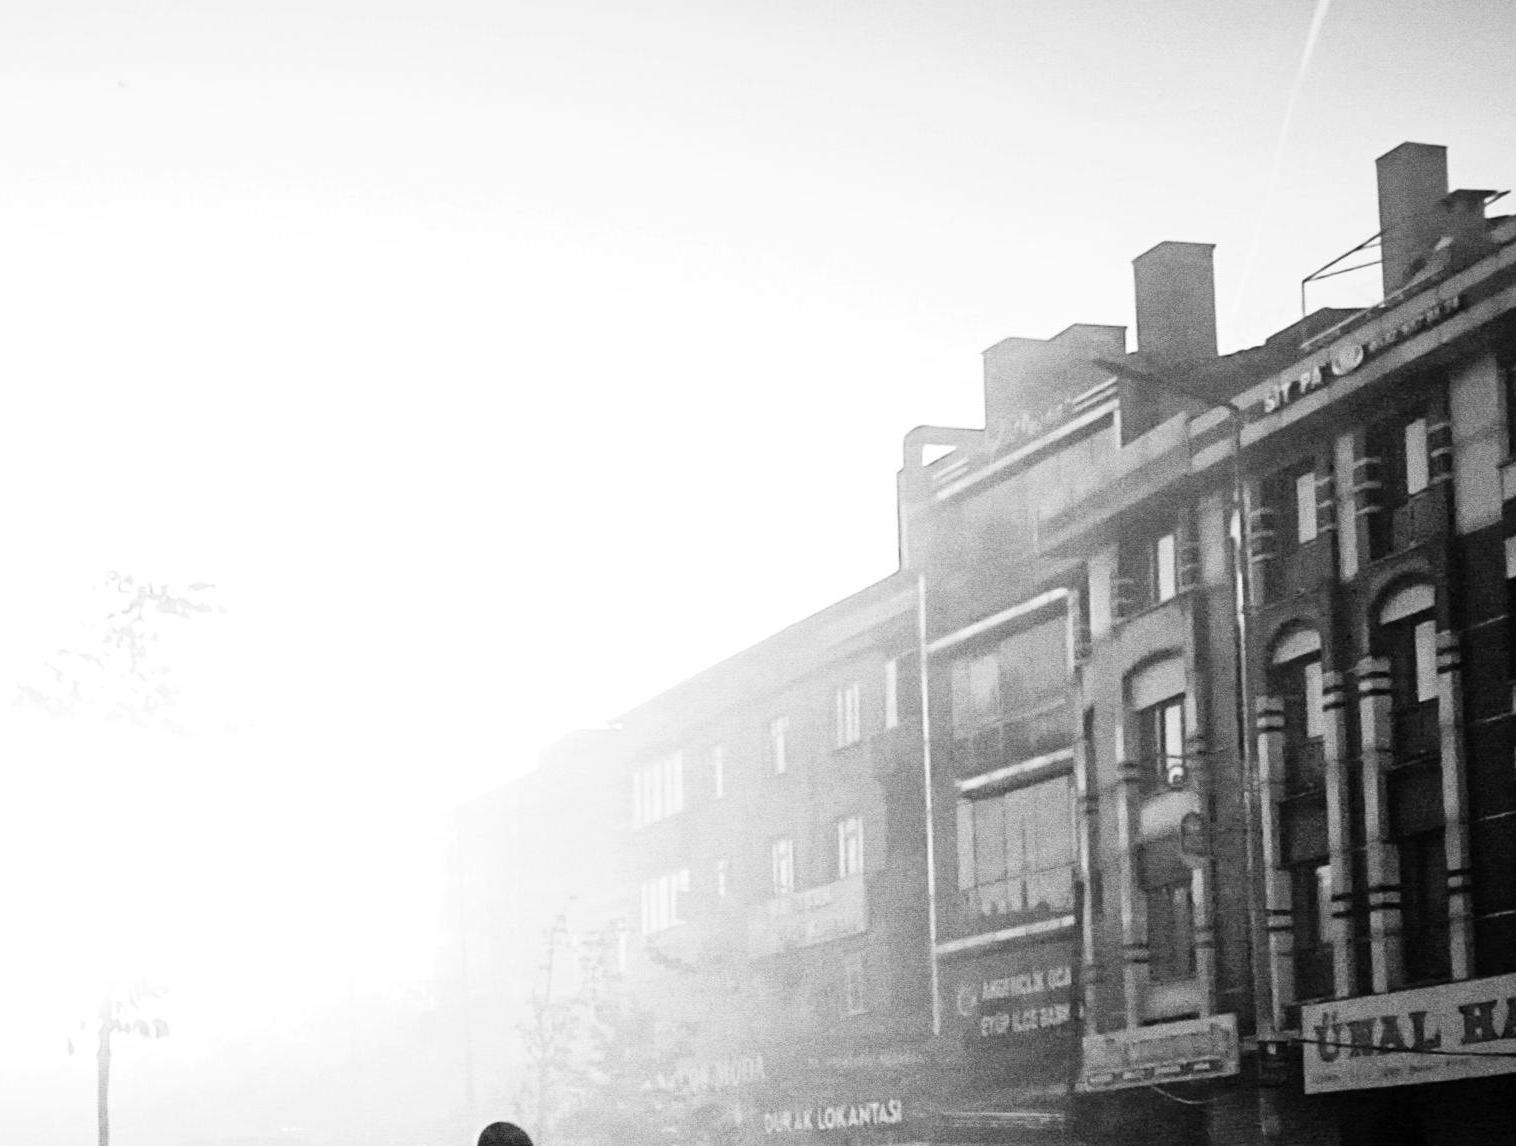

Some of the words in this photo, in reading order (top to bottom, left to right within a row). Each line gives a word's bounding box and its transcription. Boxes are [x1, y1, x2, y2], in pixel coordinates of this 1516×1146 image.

[1313, 1010, 1442, 1063] ÜNAL
[764, 1109, 814, 1135] DURAK
[817, 1098, 903, 1131] LOKANTASI
